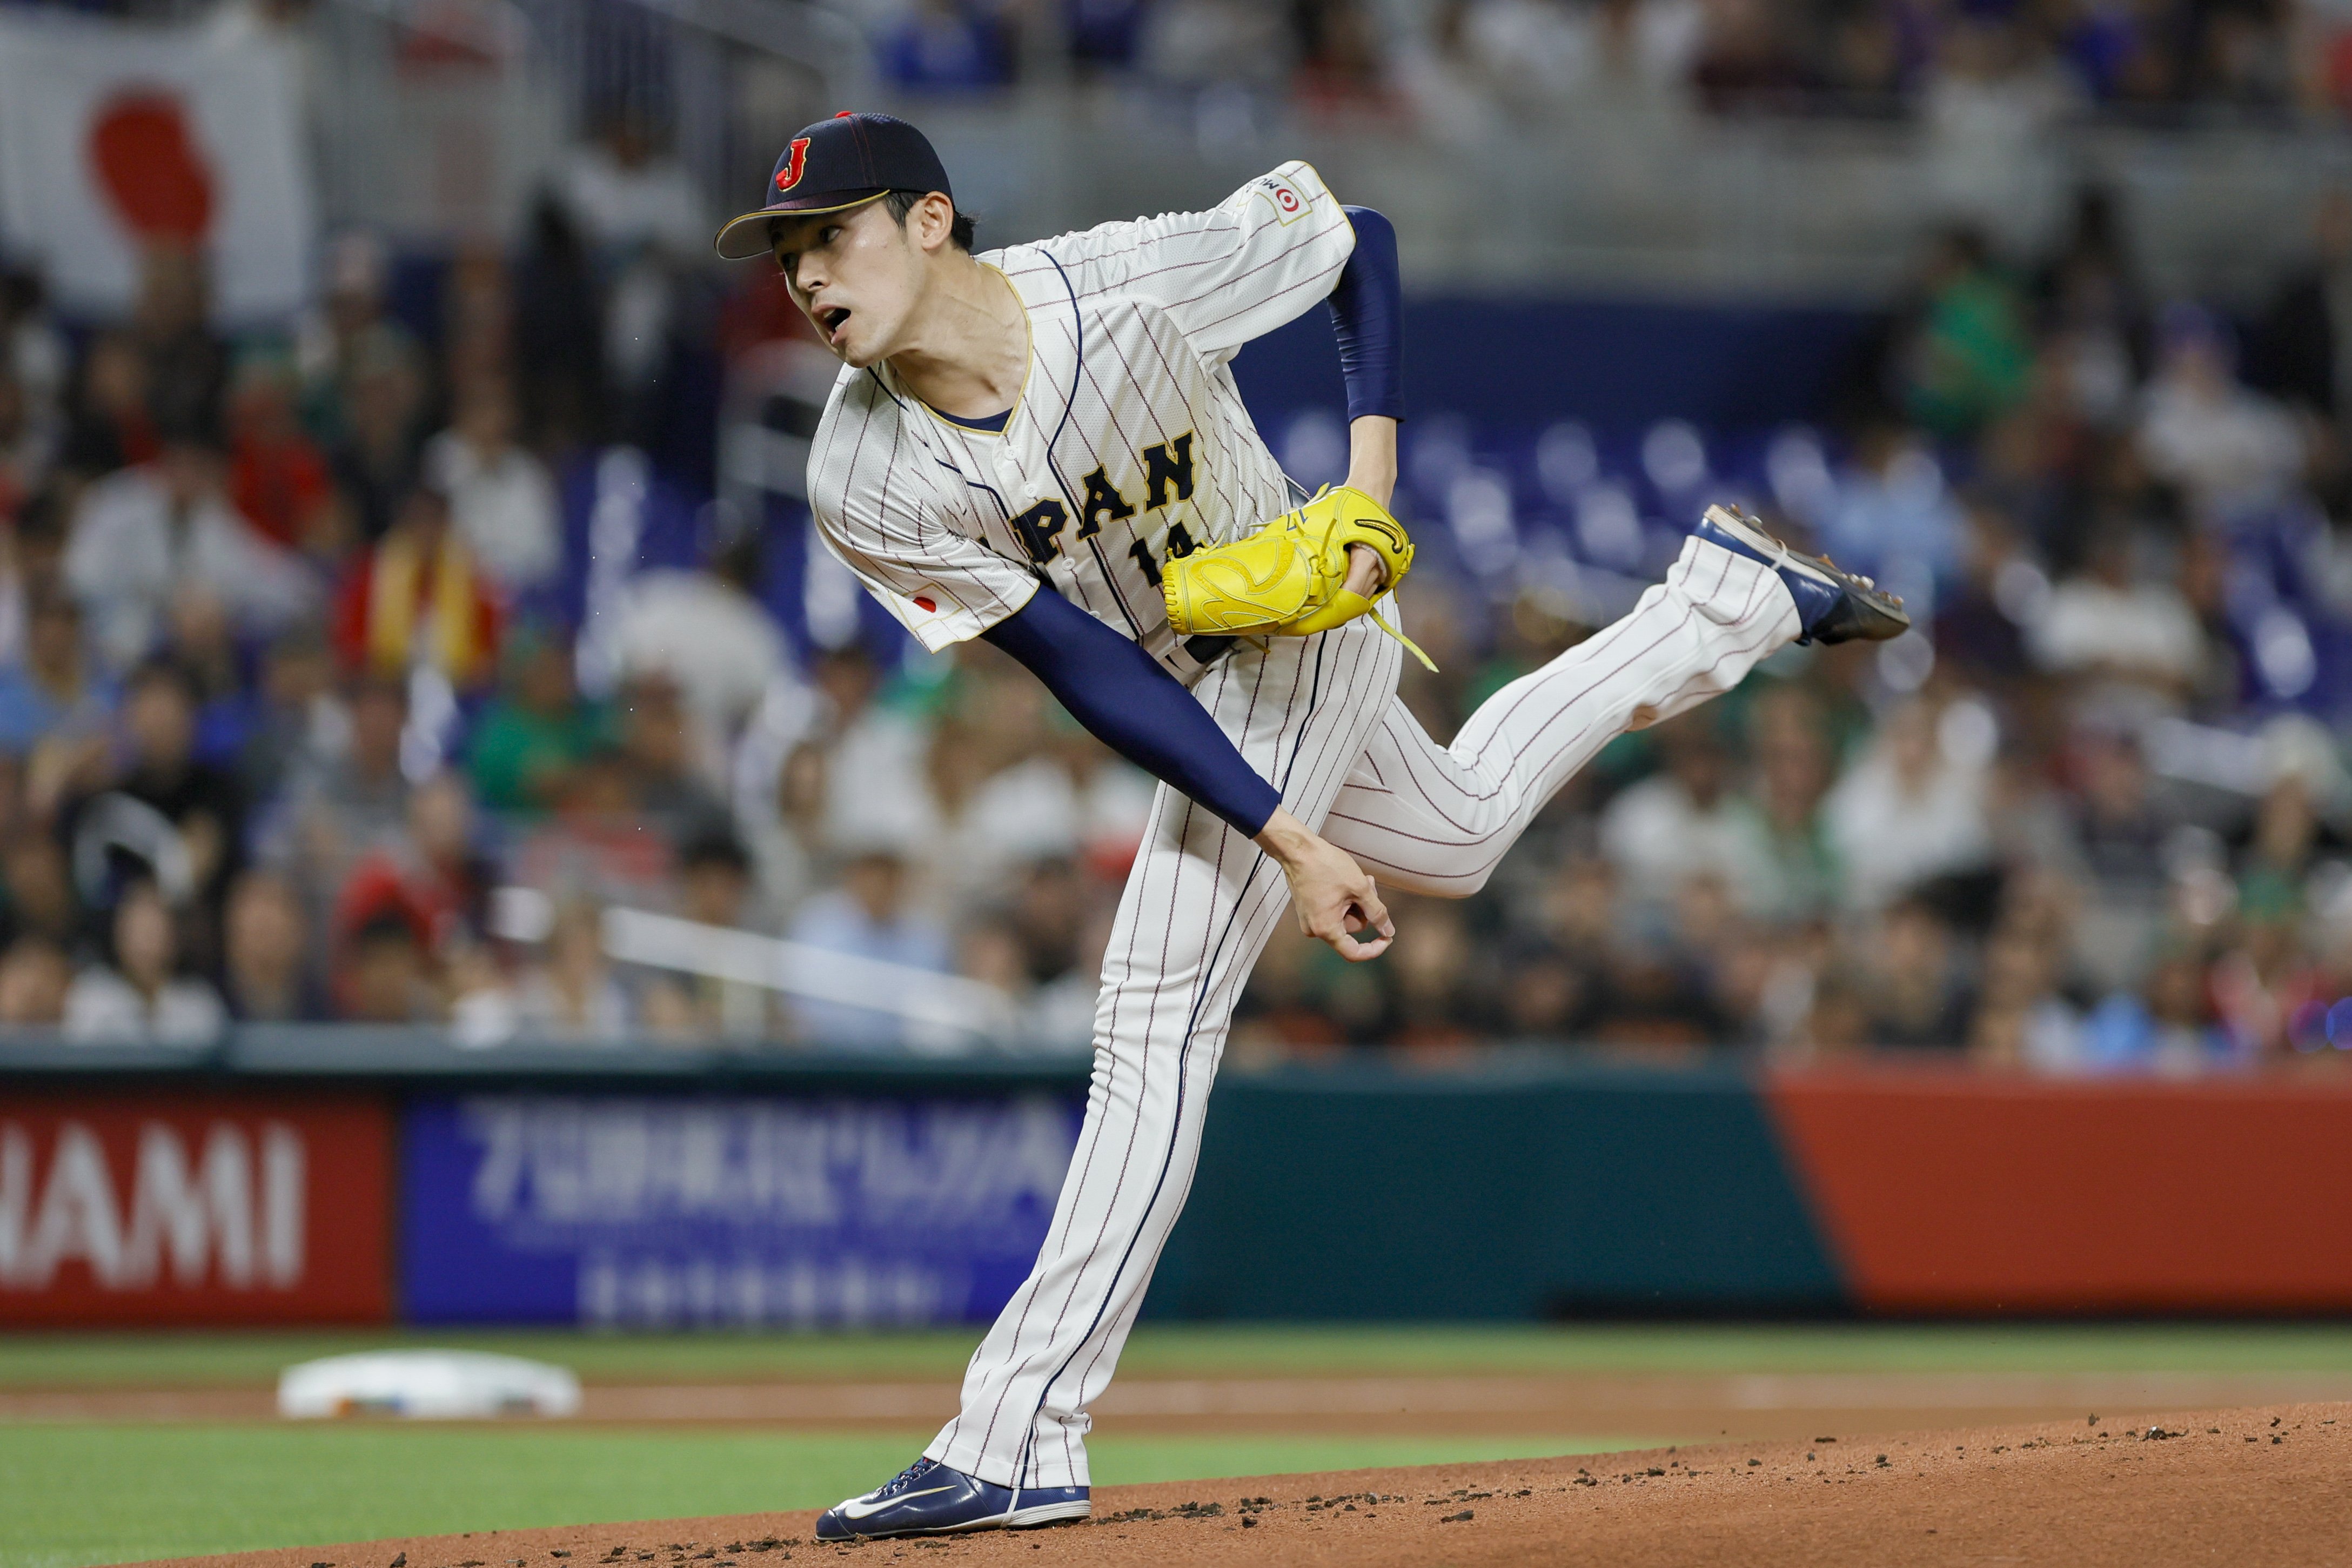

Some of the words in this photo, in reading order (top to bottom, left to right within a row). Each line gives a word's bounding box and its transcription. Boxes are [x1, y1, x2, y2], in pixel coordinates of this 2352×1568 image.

[775, 137, 810, 192] J
[977, 431, 1195, 567] PAN
[1128, 519, 1206, 588] 14
